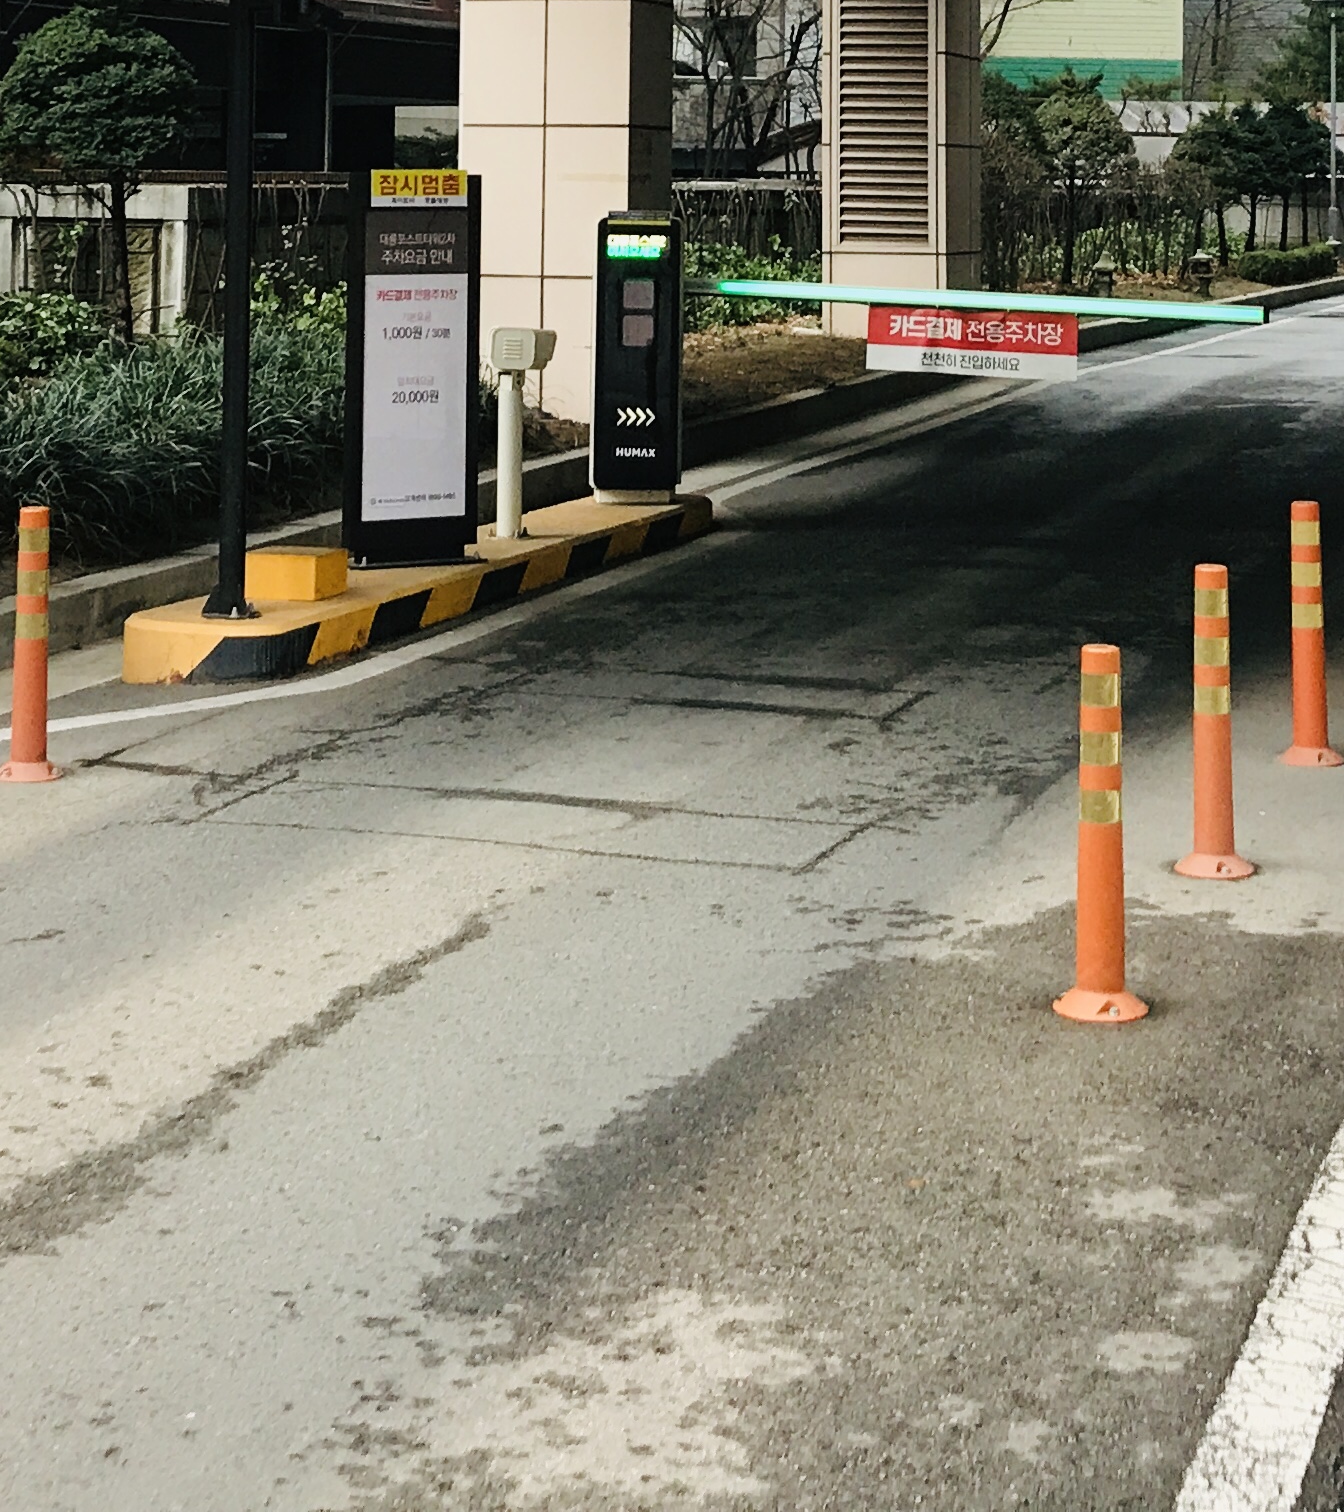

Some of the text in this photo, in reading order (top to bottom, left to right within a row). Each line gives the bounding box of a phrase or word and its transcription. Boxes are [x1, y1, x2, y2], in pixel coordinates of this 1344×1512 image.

[379, 174, 460, 196] 잠시멈춤
[381, 249, 453, 265] 주차요금 안내
[382, 326, 423, 340] 1,000원
[888, 314, 1064, 346] 카드결제 전용주차장
[921, 351, 1020, 372] 천천히 진입하세요
[392, 389, 439, 405] 20,000원
[616, 447, 655, 458] HUMAX
